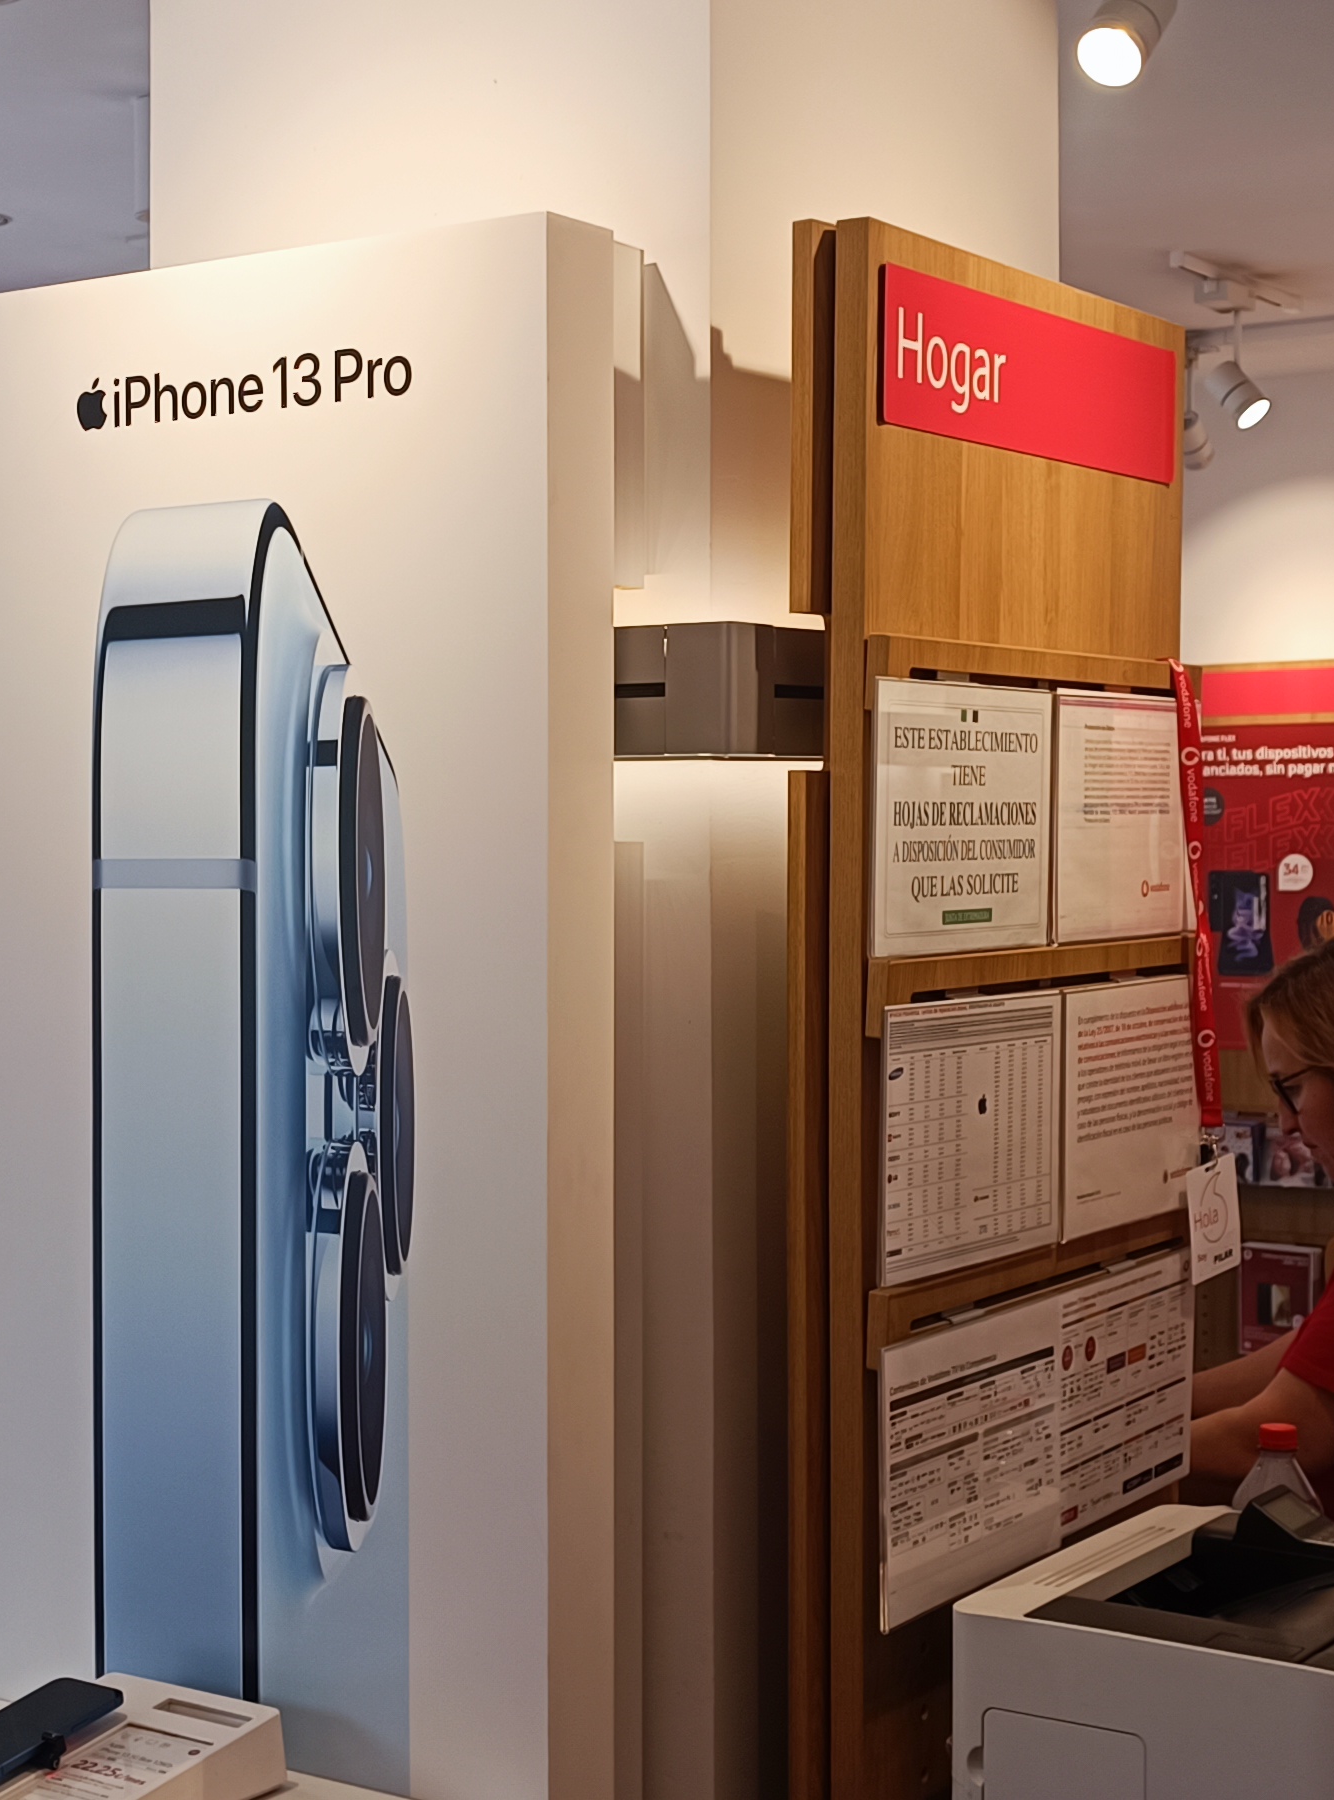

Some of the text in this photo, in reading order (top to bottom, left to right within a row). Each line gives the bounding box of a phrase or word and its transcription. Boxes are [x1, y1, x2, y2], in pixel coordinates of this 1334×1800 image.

[897, 306, 1007, 414] Hogar
[113, 348, 412, 428] iPhone 13 Pro
[1179, 674, 1192, 728] vodafone
[894, 726, 1038, 753] ESTE ESTABLECIMIENTO
[1217, 747, 1230, 761] ti,
[1232, 748, 1253, 760] tus
[1255, 745, 1334, 764] dispositivos
[951, 764, 986, 786] TIENE
[1202, 762, 1263, 777] anciados,
[1266, 762, 1285, 776] sin
[1288, 763, 1324, 778] pagar
[1186, 768, 1198, 822] vodafone
[893, 801, 1037, 829] HOJAS DE RECLAMACIONES
[893, 834, 1036, 863] A DISPOSICIÓN DEL CONSUMIDOR
[911, 873, 1019, 902] QUE LAS SOLICITE
[1197, 959, 1208, 1012] vodafone
[1202, 1050, 1214, 1103] vodafone
[1194, 1206, 1219, 1233] Hola
[1213, 1249, 1234, 1265] PILAR
